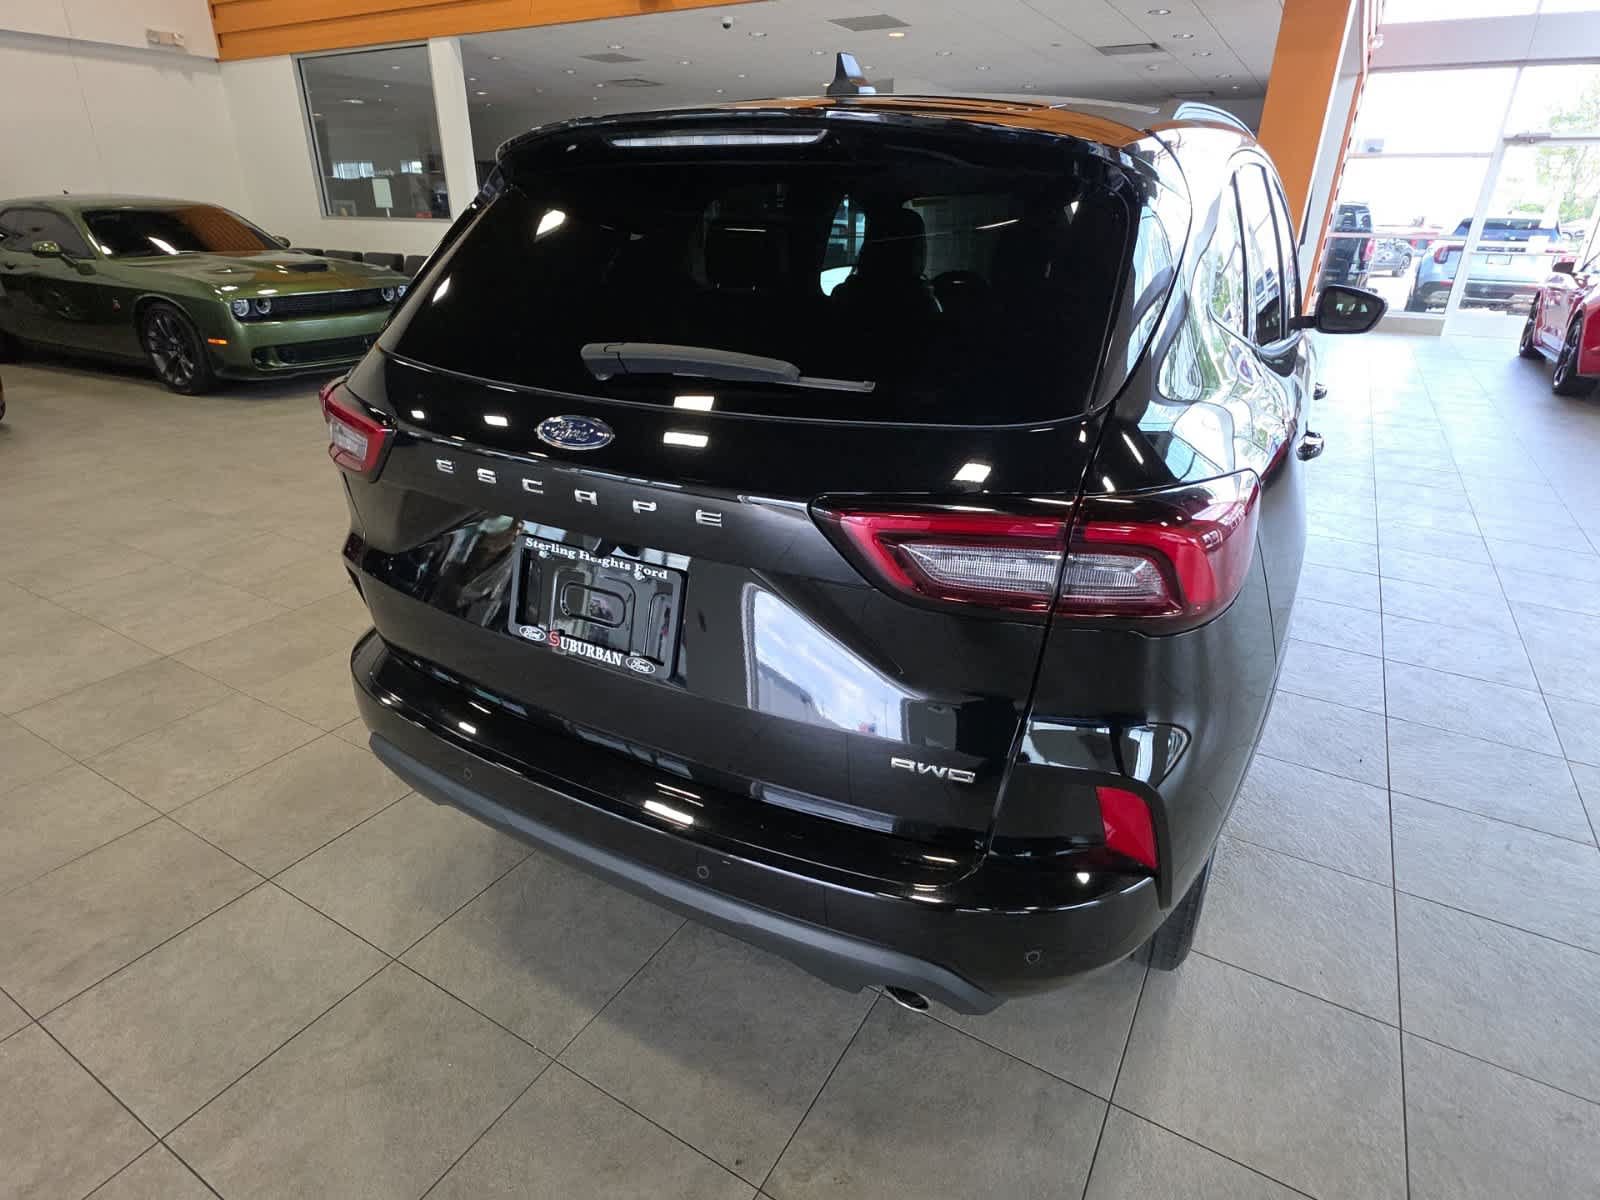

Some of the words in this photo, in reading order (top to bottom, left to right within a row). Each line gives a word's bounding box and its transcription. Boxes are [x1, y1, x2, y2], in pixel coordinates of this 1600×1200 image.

[435, 458, 723, 528] ESCAPE
[525, 537, 577, 560] Sterling
[579, 549, 631, 571] Heights
[634, 562, 668, 580] Ford
[548, 630, 624, 667] SUBURBAN
[890, 756, 976, 784] AWD
